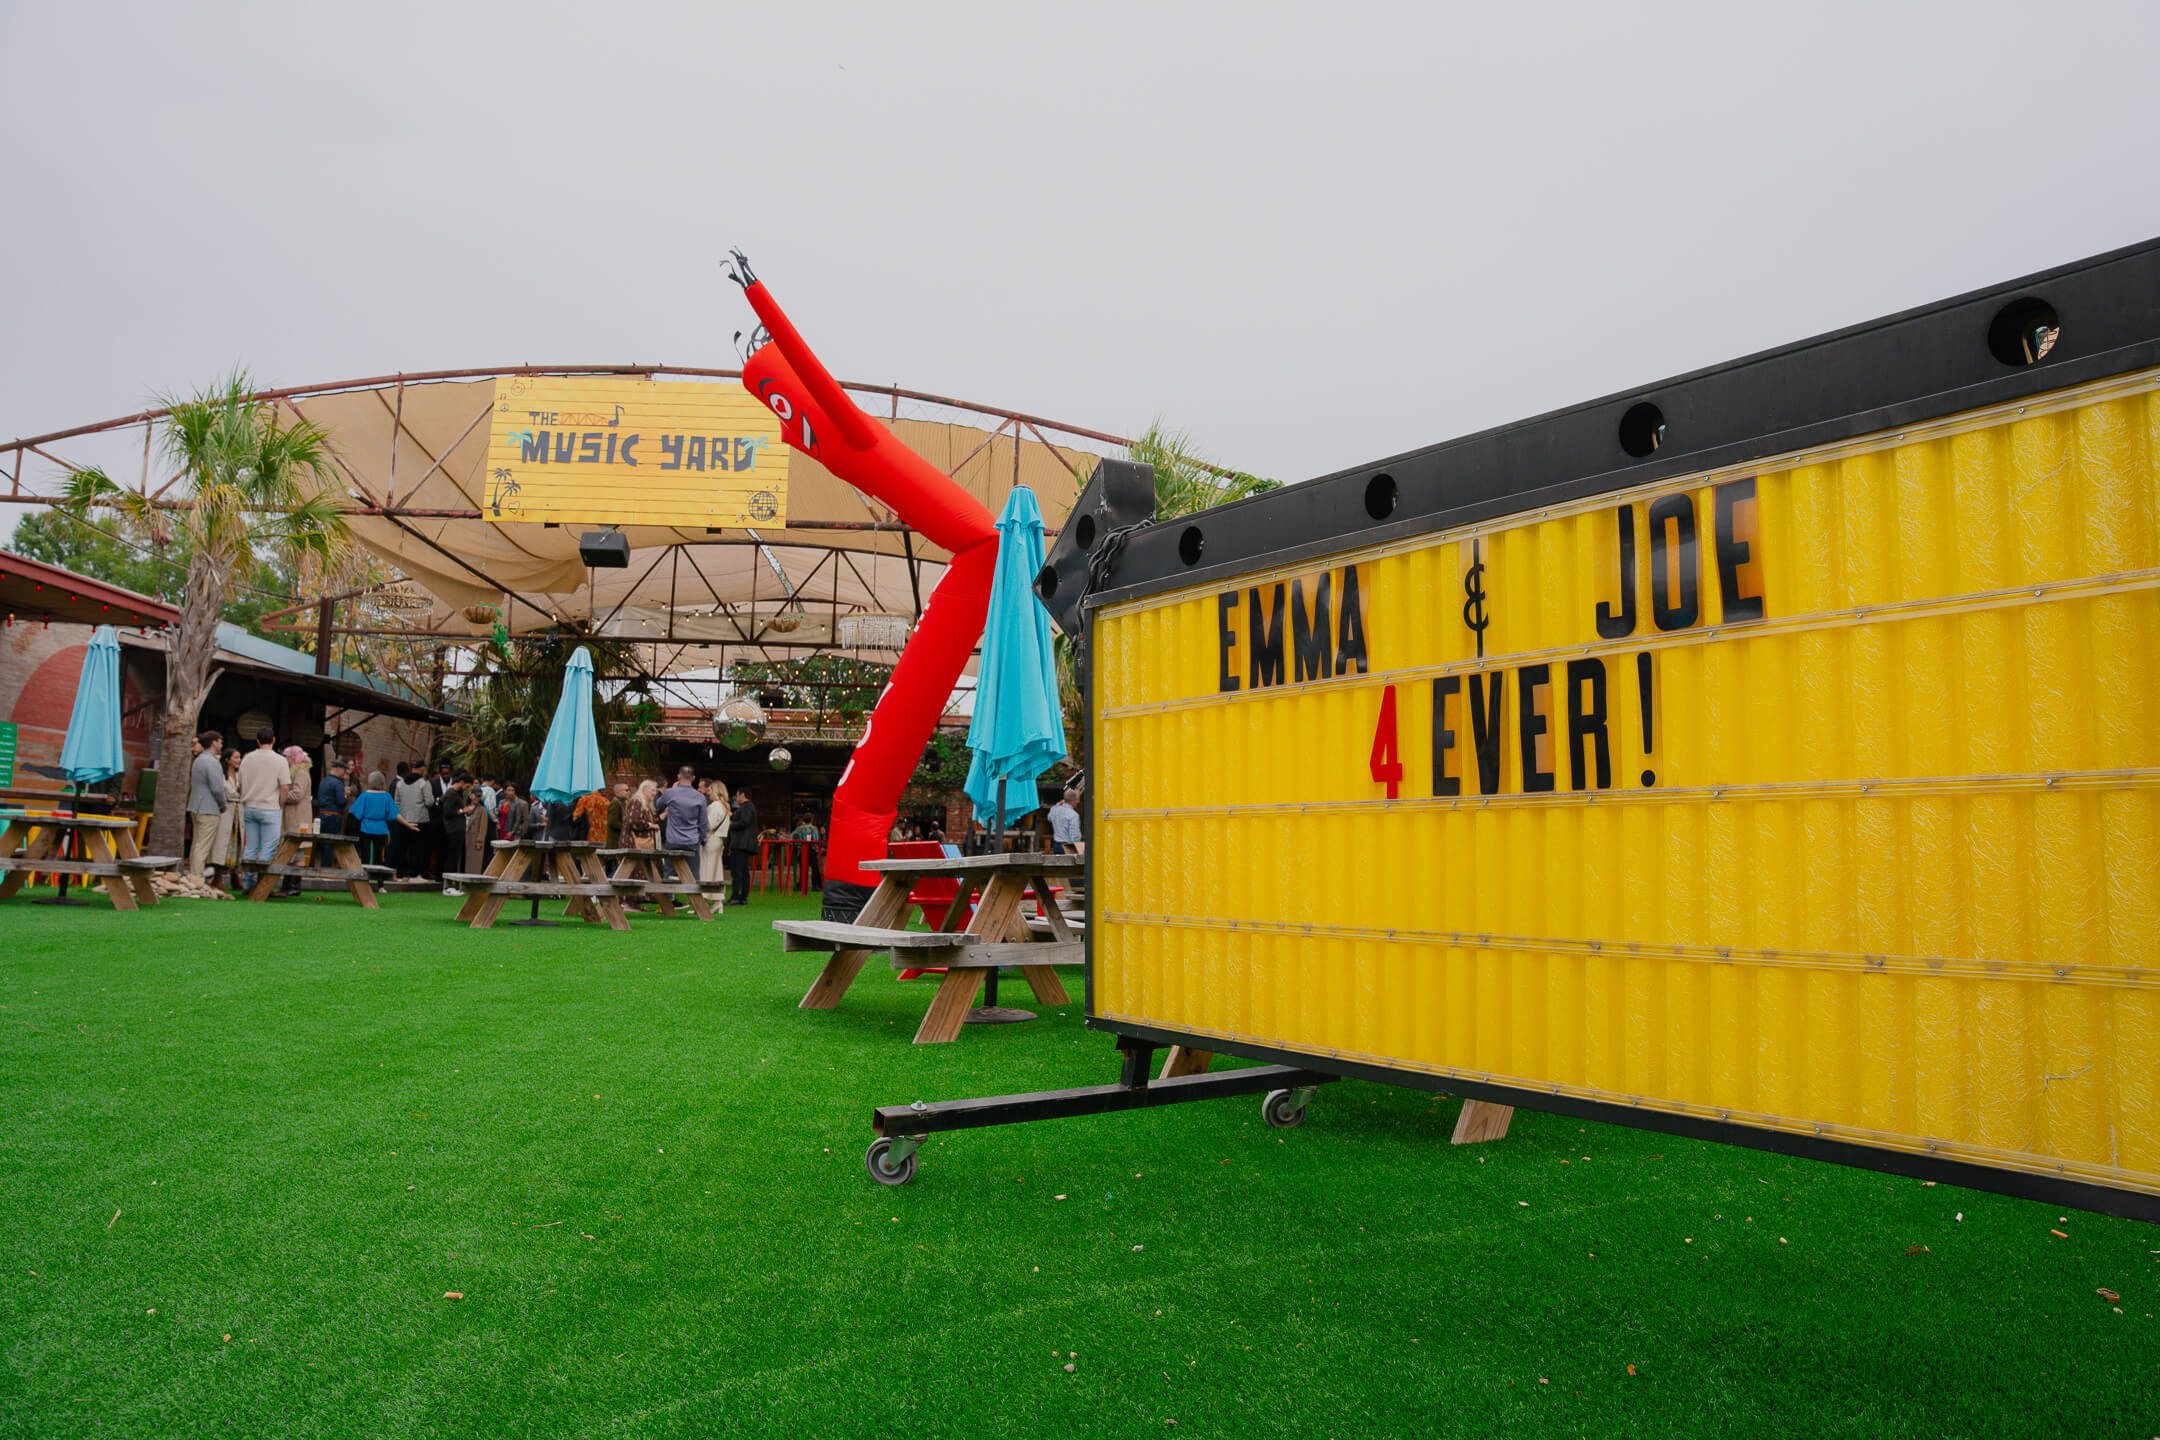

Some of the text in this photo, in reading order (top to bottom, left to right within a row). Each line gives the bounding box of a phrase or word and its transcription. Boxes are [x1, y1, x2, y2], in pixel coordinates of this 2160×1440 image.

[521, 430, 752, 472] MUSIC YARD
[529, 411, 559, 426] THE
[1218, 477, 1764, 692] EMMA & JOE
[1369, 651, 1656, 799] 4 EVER!
